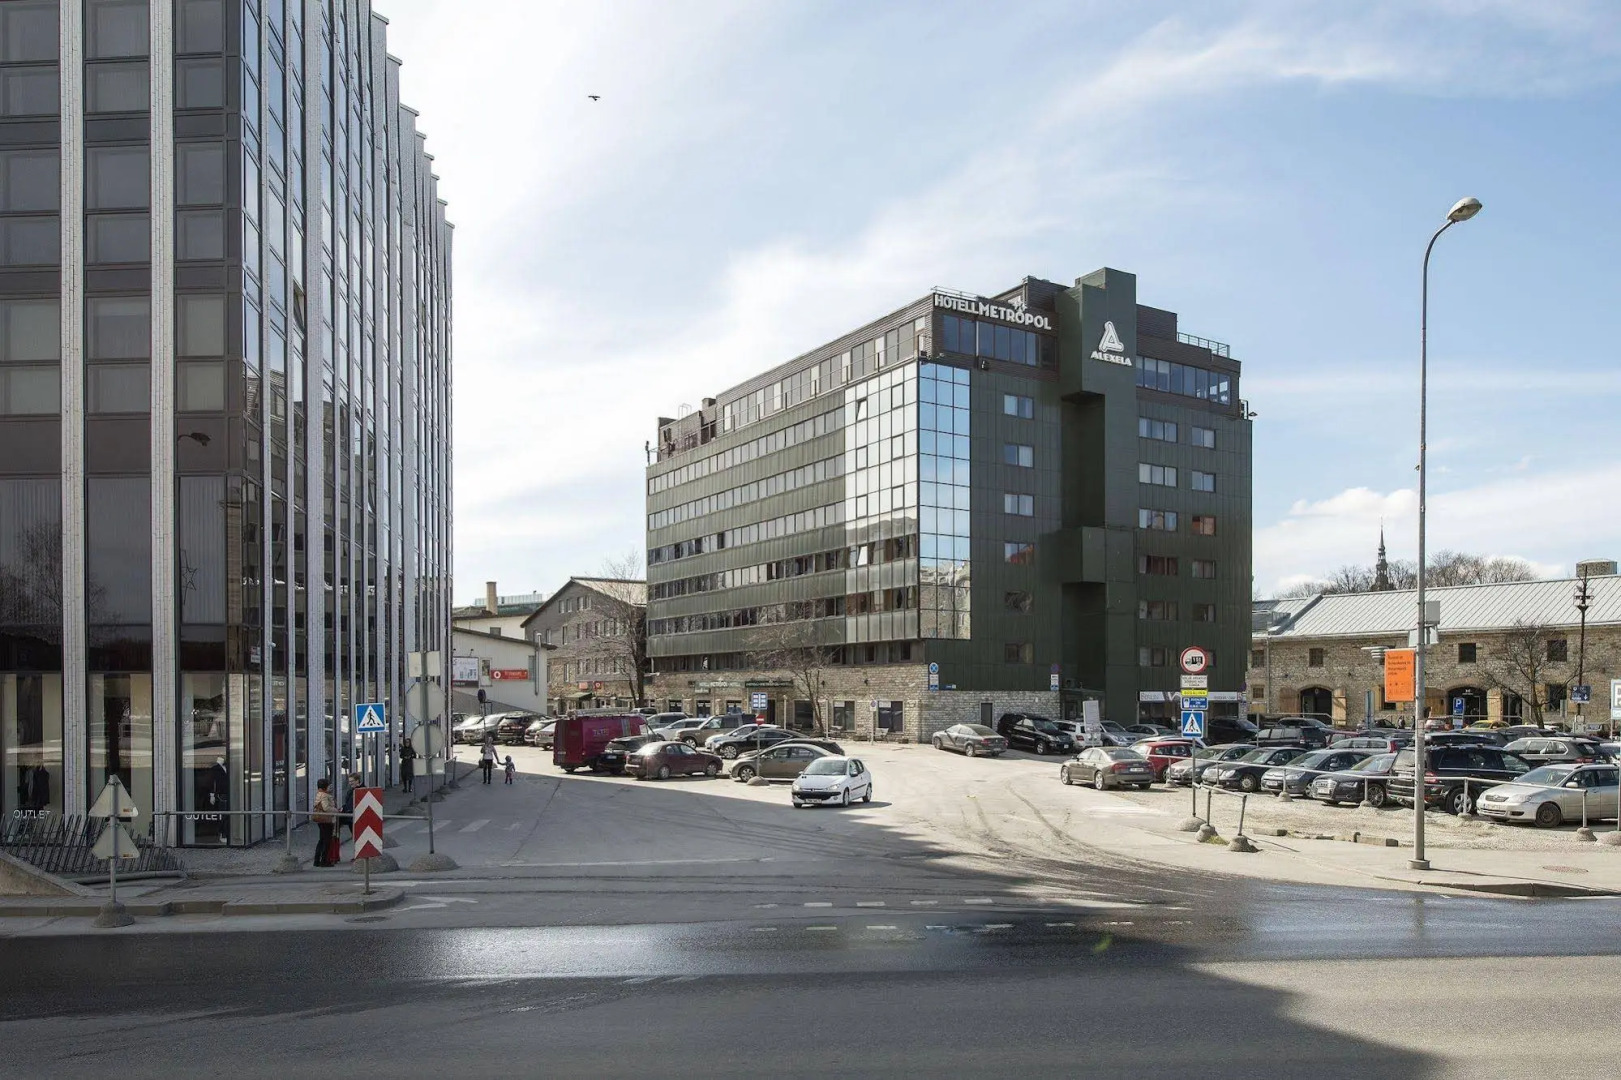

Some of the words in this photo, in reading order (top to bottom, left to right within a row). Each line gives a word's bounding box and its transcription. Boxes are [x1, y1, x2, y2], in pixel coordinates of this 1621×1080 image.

[935, 294, 979, 314] HOTELL
[979, 302, 1052, 330] METROPOL
[1090, 351, 1132, 366] ALEXELA
[1456, 699, 1462, 707] P
[14, 809, 51, 819] OUTLET
